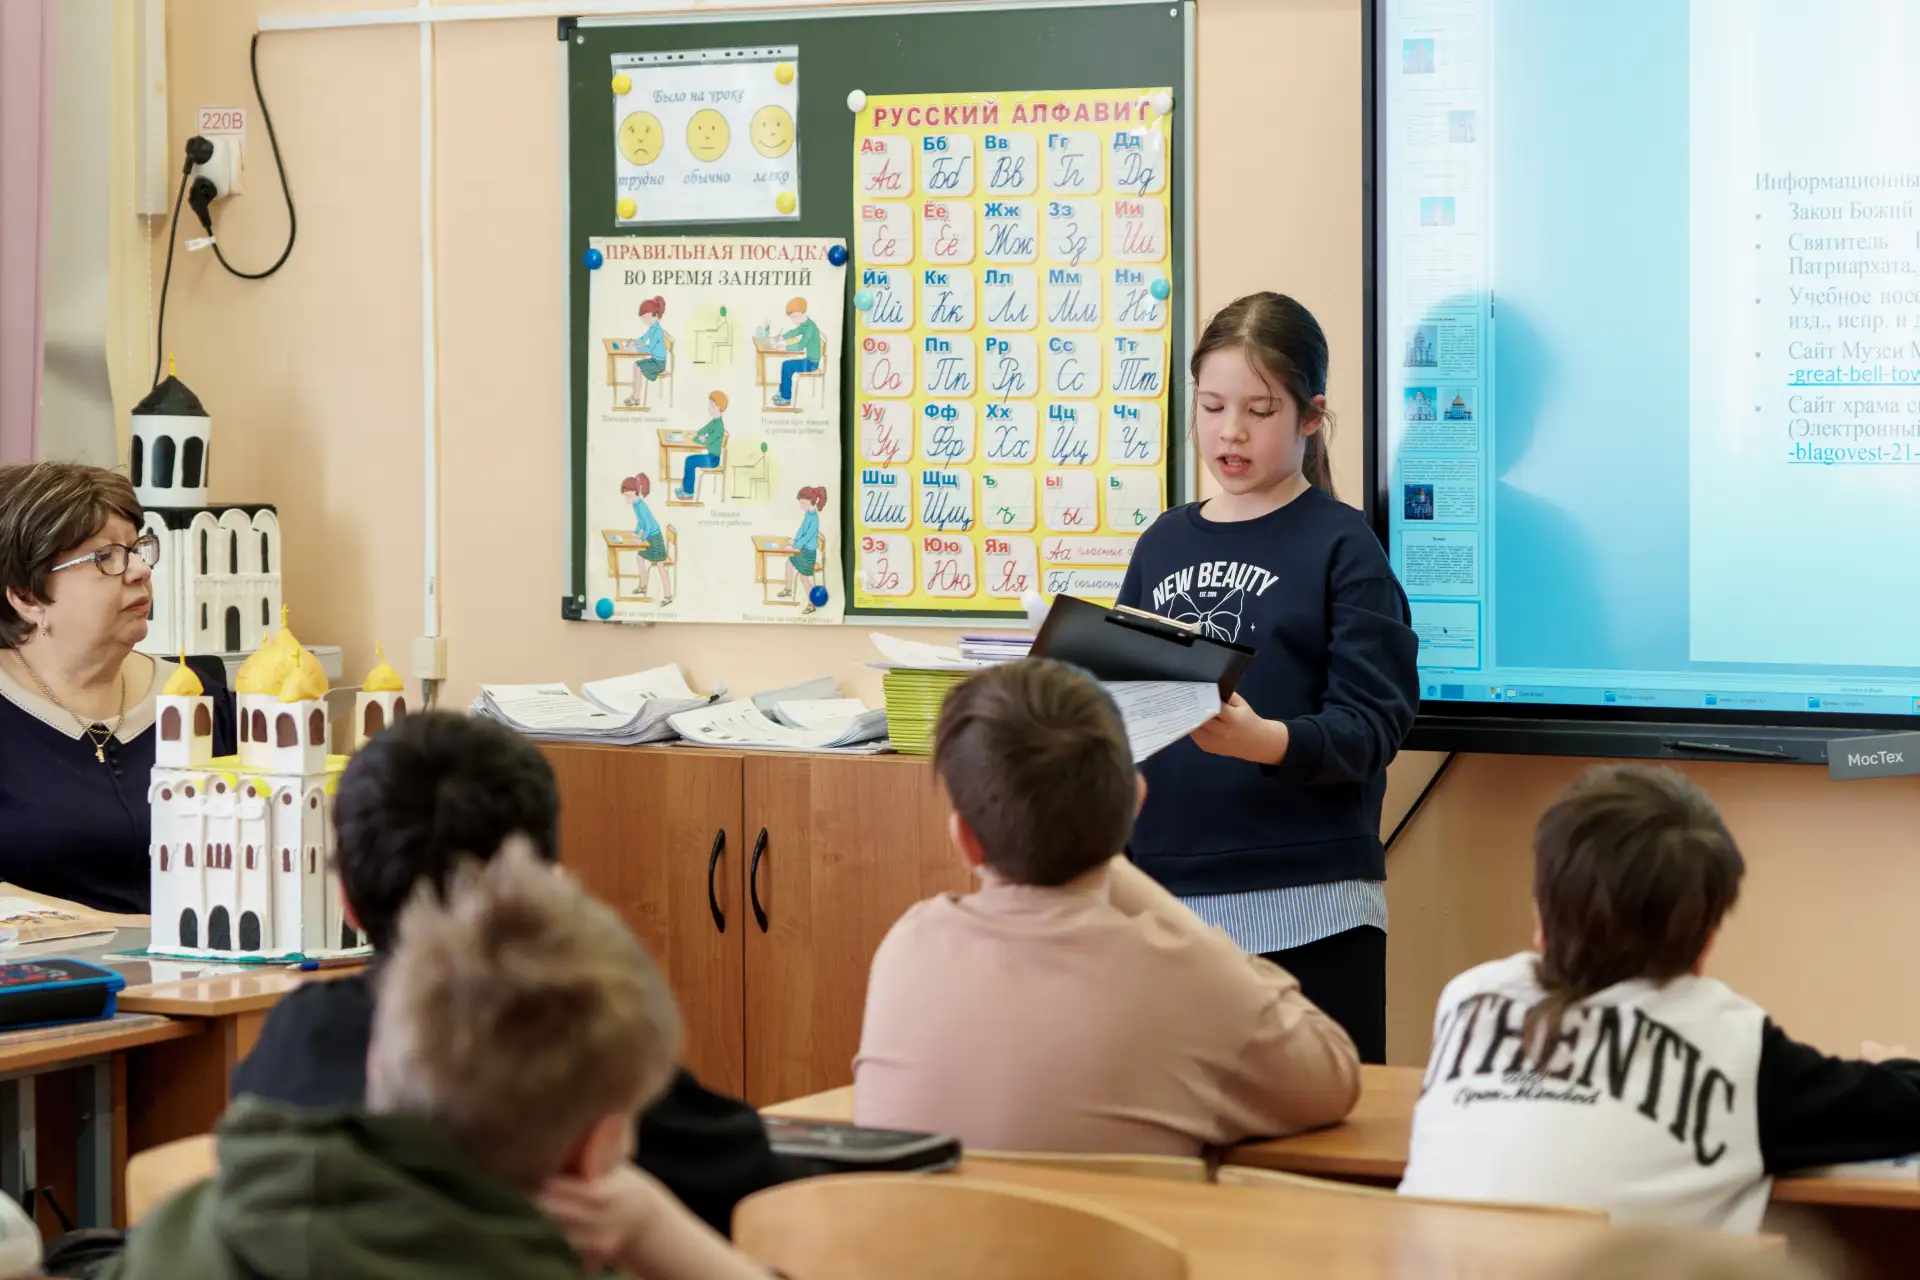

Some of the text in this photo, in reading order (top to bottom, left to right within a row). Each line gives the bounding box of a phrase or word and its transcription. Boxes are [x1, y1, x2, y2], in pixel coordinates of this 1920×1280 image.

[690, 90, 705, 101] на
[202, 112, 243, 130] 220В
[874, 98, 1151, 128] РУССКИЙ АЛФАВИТ
[861, 132, 1140, 153] Аа Бб Вв Гг Дд
[617, 171, 665, 190] трудно
[684, 169, 731, 185] обычно
[862, 201, 1141, 219] Ее Ёё Жж Зз Ии
[1788, 200, 1913, 220] Закон Божий
[1788, 232, 1888, 251] Святитель
[605, 244, 829, 263] ПРАВИЛЬНАЯ ПОСАДКА
[623, 267, 812, 286] ВО ВРЕМЯ ЗАНЯТИЙ
[863, 268, 1142, 286] Йй Кк Лл Мм Нн
[1788, 286, 1872, 305] Учебное
[1896, 315, 1907, 328] и
[862, 337, 1137, 356] Оо Пп Рр Сс Тт
[1788, 341, 1836, 360] Сайт
[1842, 341, 1903, 363] Музеи
[862, 403, 1138, 422] Уу Фф Хх Цц Чч
[1788, 395, 1920, 418] Сайт храма с
[1788, 418, 1920, 441] (Электронны
[862, 470, 896, 485] Шш
[922, 470, 958, 487] Щщ
[862, 537, 1009, 553] Ээ Юю Яя
[1152, 560, 1279, 611] NEW BEAUTY
